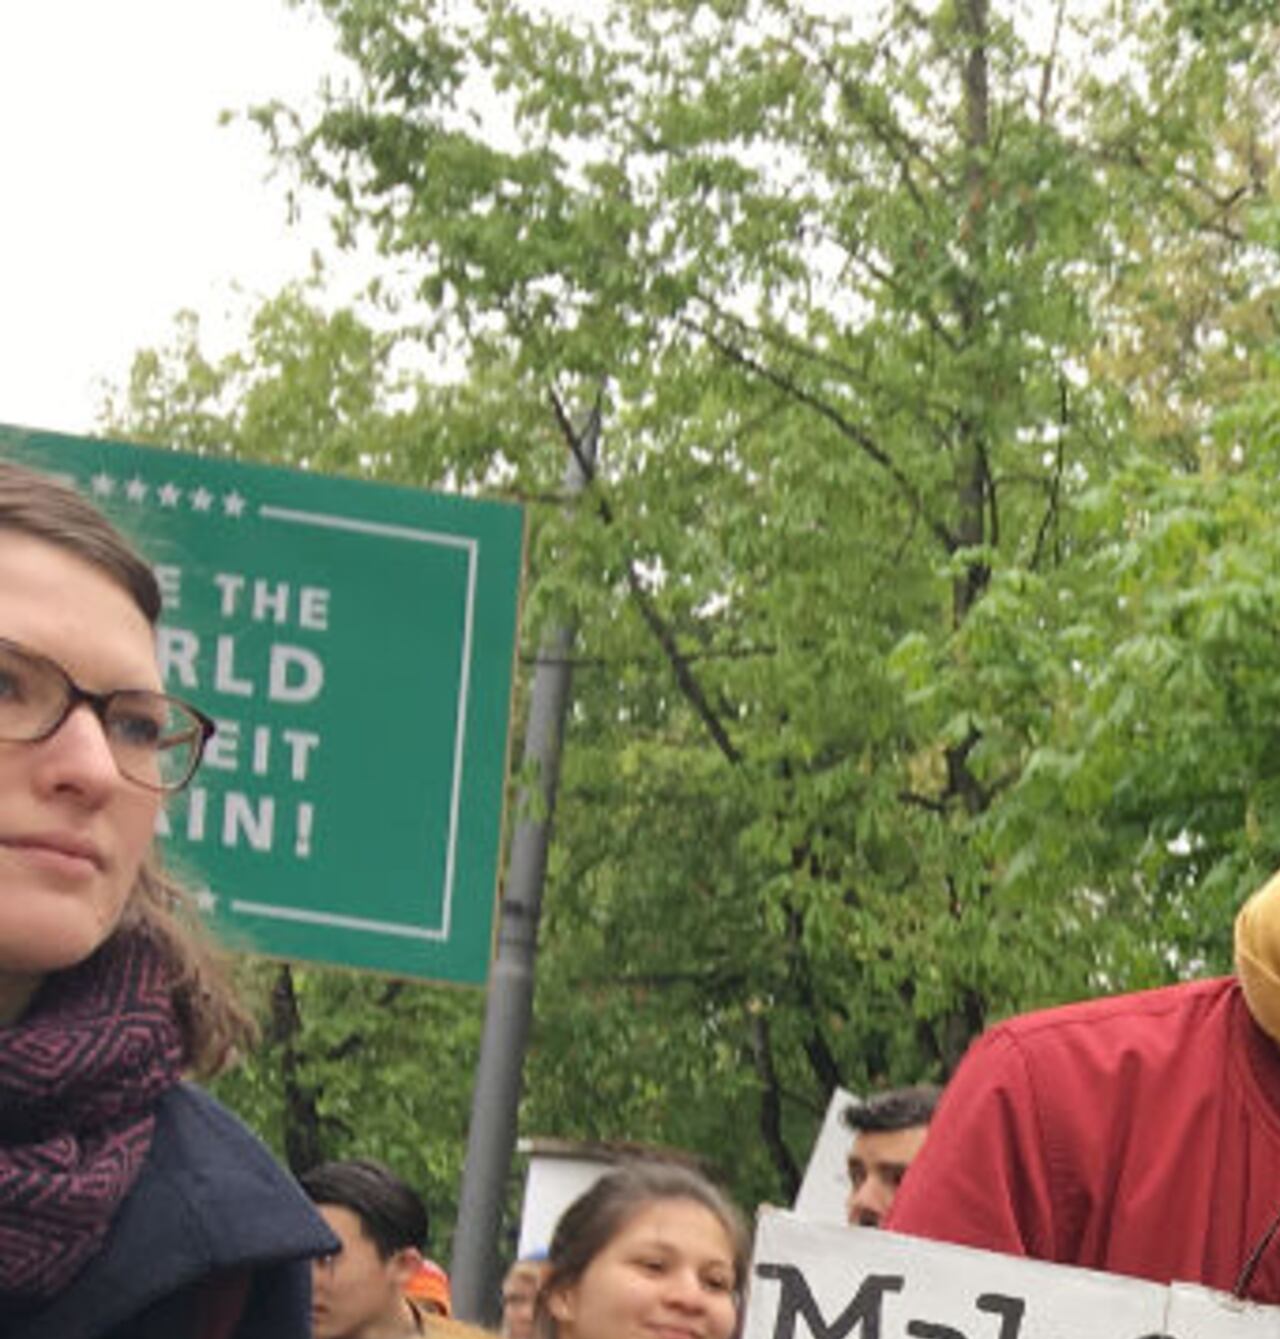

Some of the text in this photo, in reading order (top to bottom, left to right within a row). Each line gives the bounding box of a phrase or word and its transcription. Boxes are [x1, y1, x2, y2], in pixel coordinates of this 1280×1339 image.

[214, 572, 330, 631] THE
[155, 626, 325, 704] RLD
[203, 717, 320, 782] EIT
[155, 786, 315, 858] IN!
